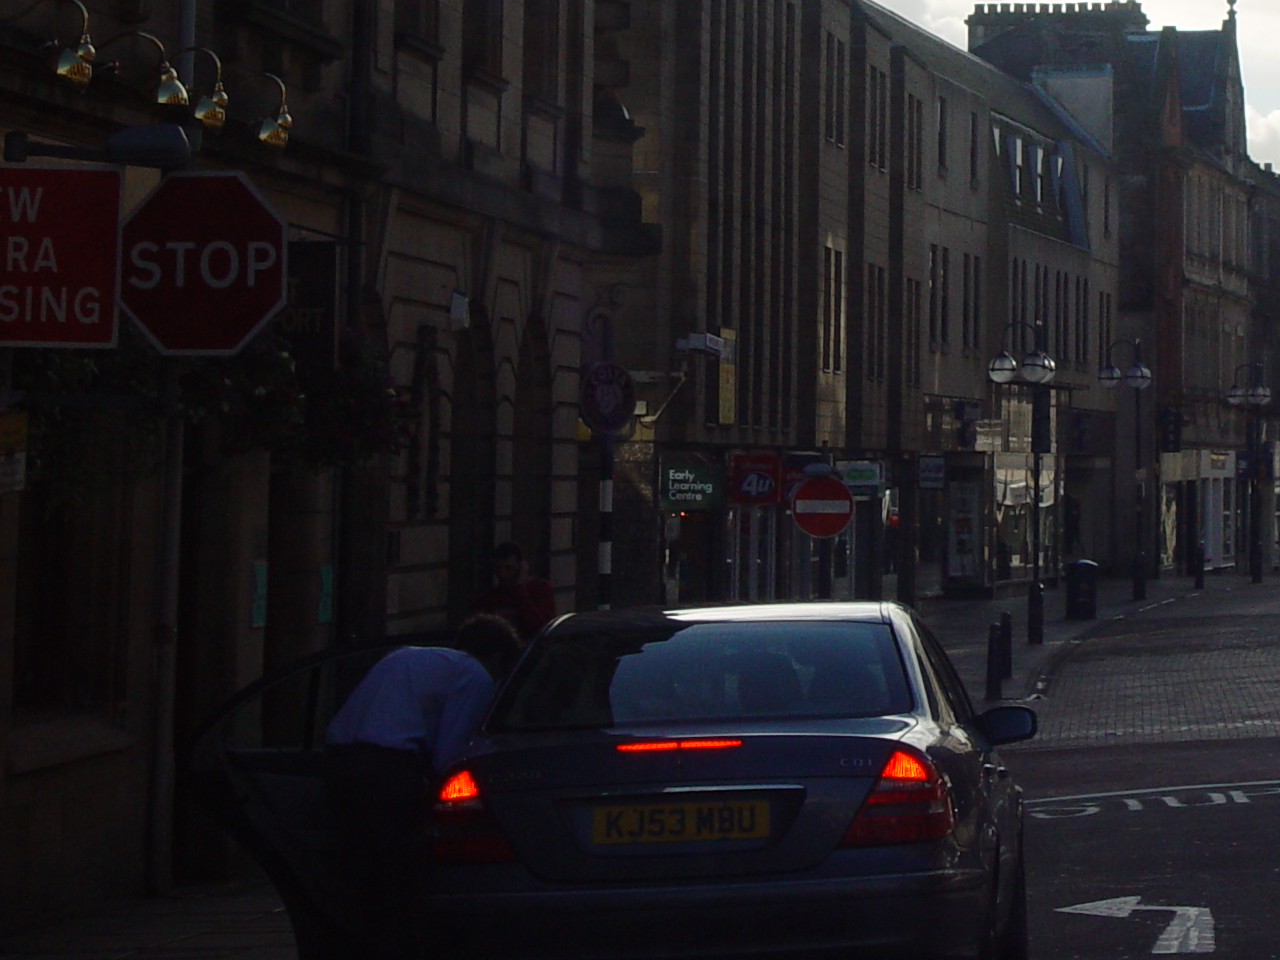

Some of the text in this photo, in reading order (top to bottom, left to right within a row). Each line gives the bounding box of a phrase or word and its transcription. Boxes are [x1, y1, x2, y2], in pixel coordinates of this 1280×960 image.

[0, 186, 43, 223] W
[129, 241, 277, 289] STOP
[669, 469, 695, 482] Early
[669, 480, 713, 494] Learning
[742, 473, 771, 496] 4u
[669, 490, 702, 501] Centre
[605, 805, 756, 838] KJ53 MBU
